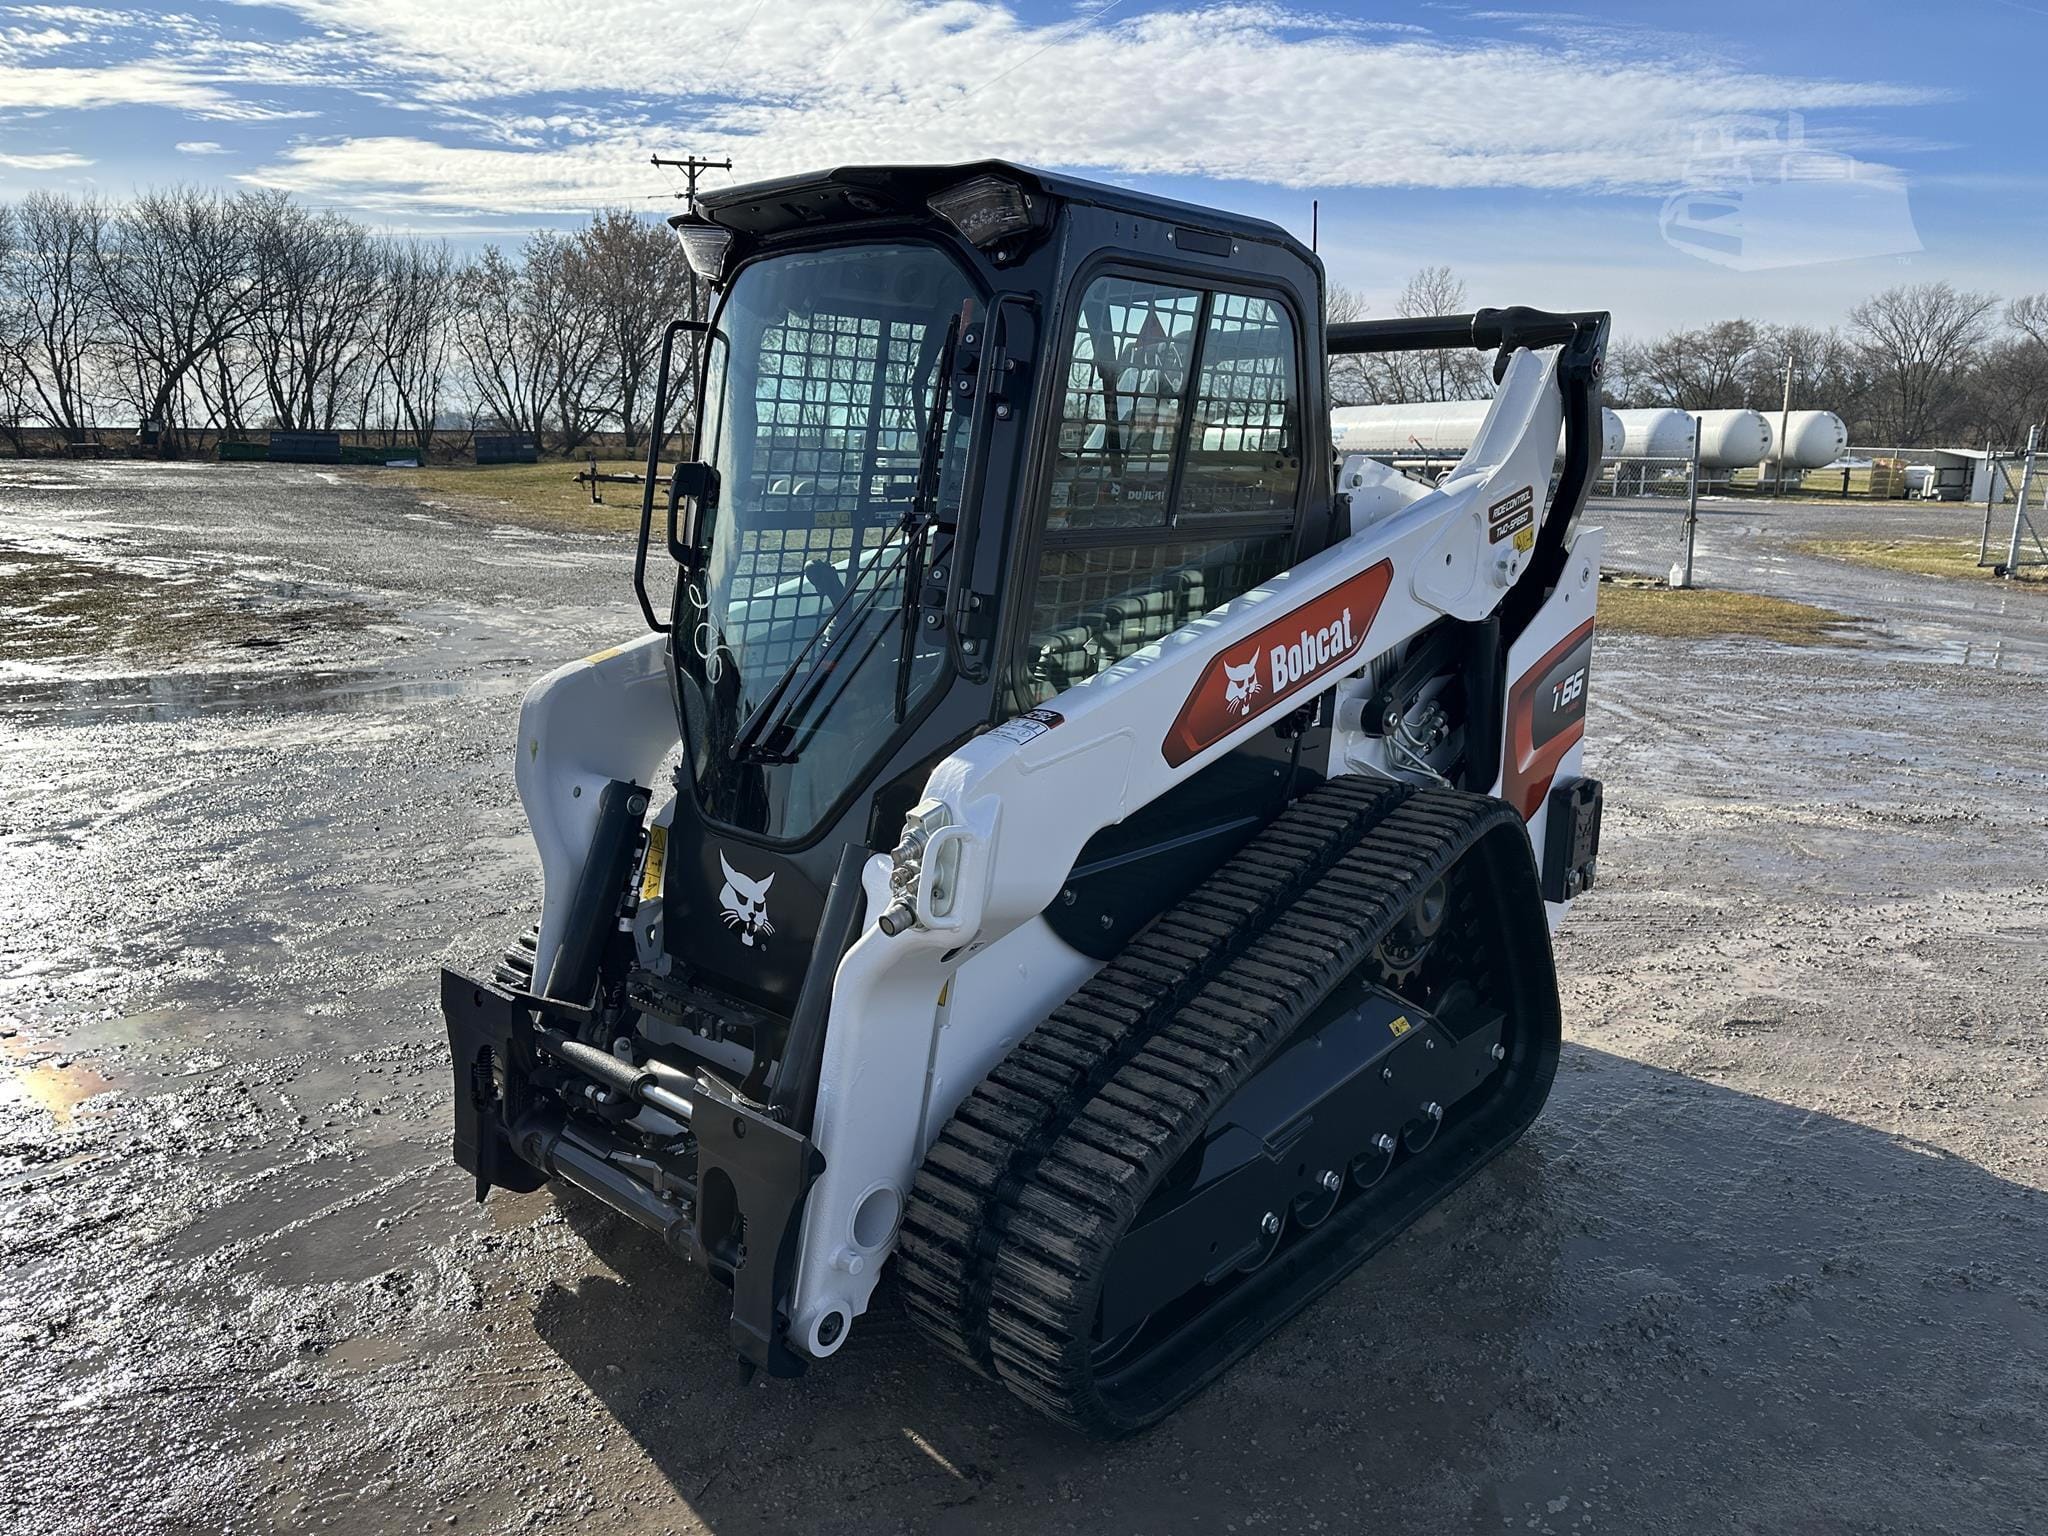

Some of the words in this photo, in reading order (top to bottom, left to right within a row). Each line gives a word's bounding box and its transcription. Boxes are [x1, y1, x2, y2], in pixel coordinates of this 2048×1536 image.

[1505, 490, 1531, 512] CONTROL
[1496, 511, 1529, 537] TWO-SPEED
[1270, 607, 1352, 694] Bobcat
[1552, 667, 1585, 713] T66
